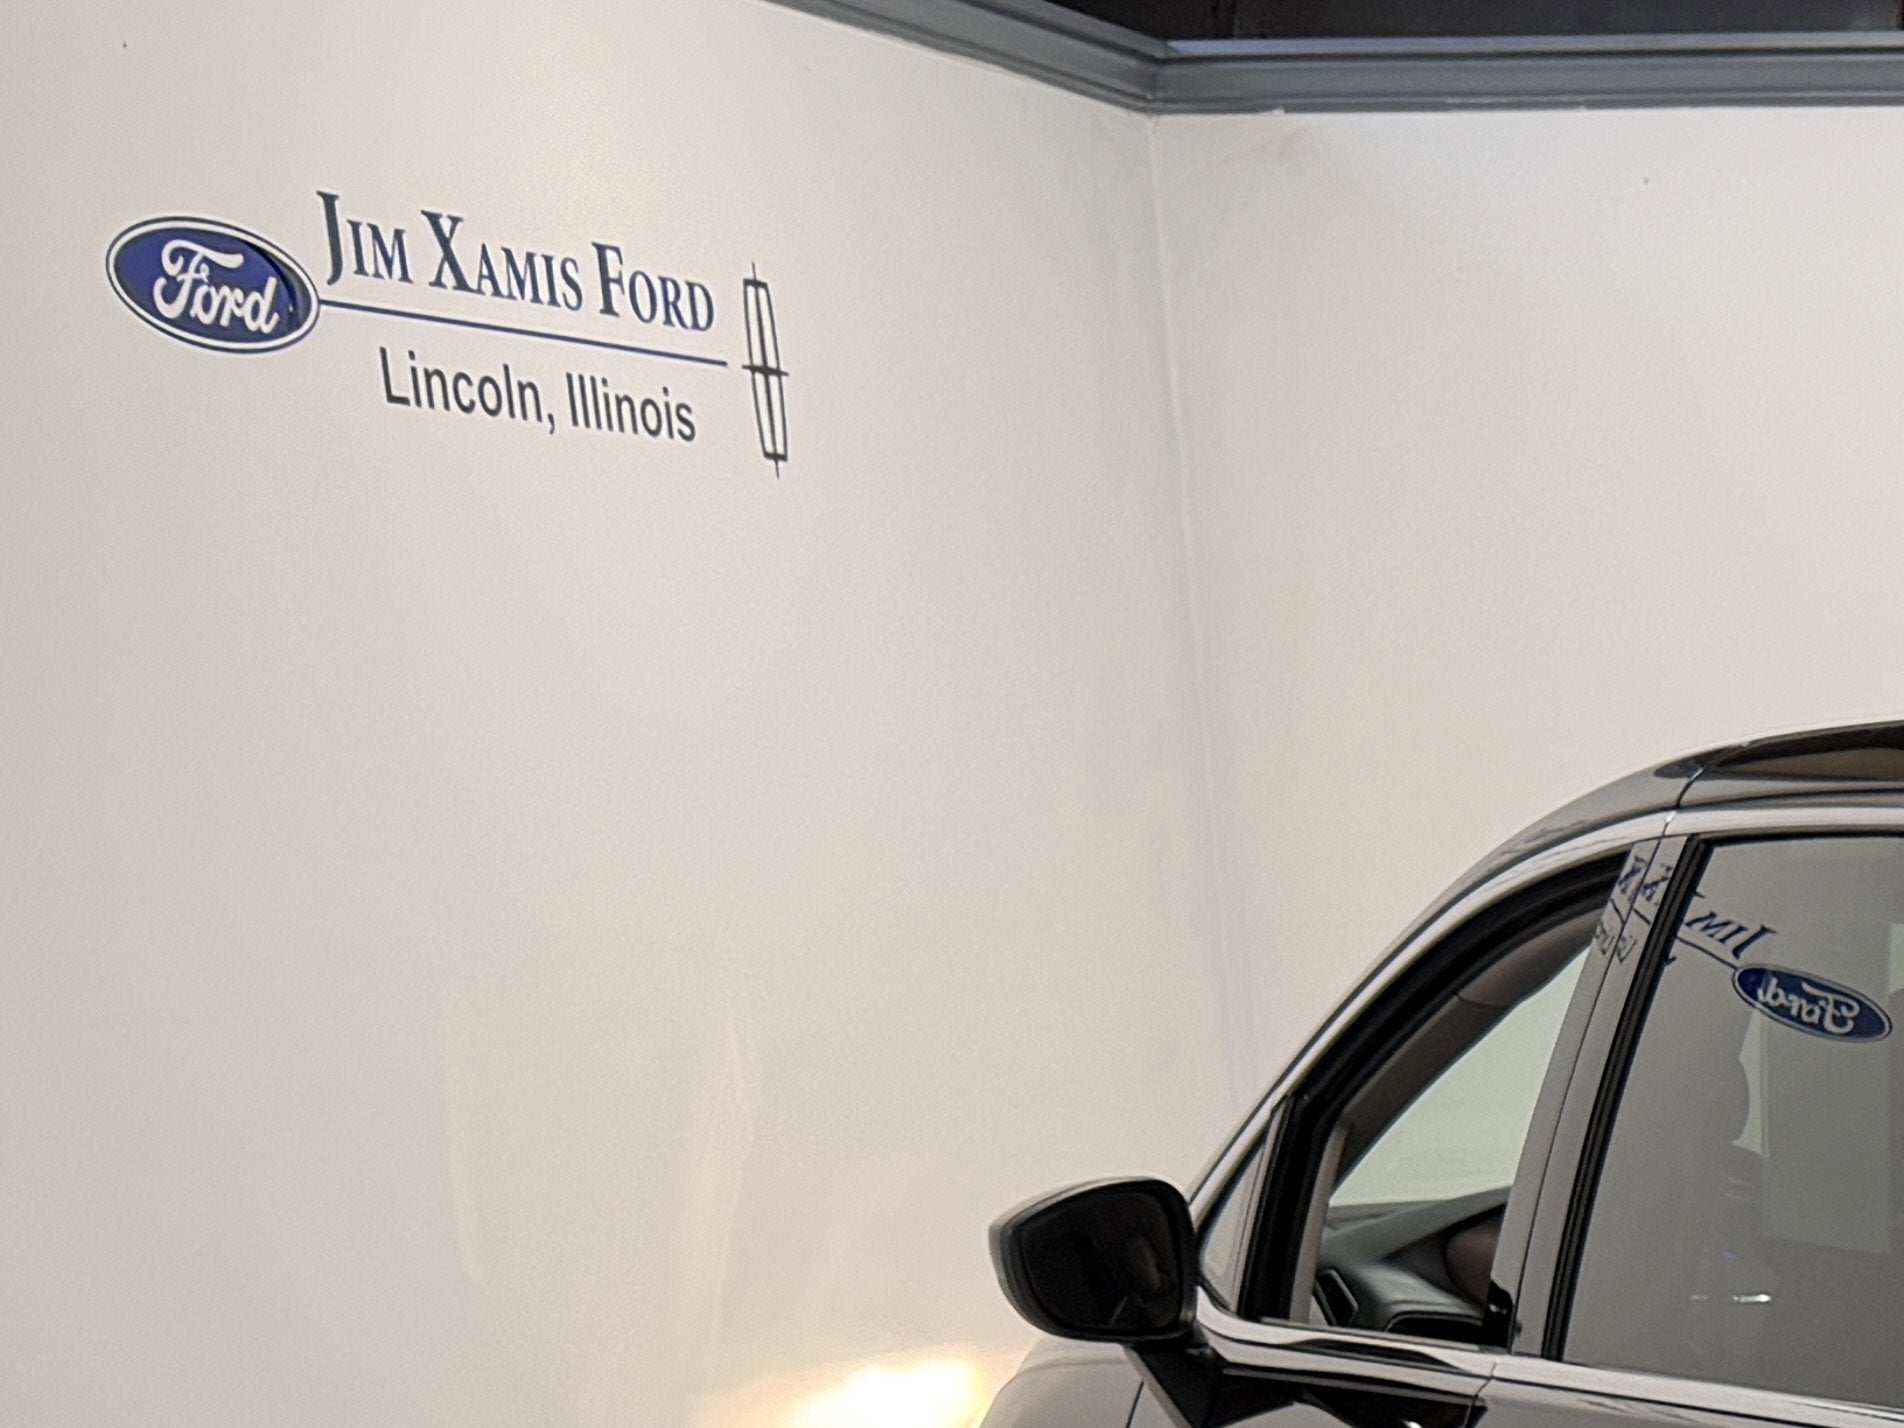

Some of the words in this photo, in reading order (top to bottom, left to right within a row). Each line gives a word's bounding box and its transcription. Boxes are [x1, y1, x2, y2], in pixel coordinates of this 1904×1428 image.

[154, 239, 280, 335] Ford
[316, 190, 412, 286] JIM
[420, 209, 582, 311] XAMIS
[592, 241, 716, 333] FORD
[380, 346, 556, 434] Lincoln,
[567, 372, 696, 442] Illinois
